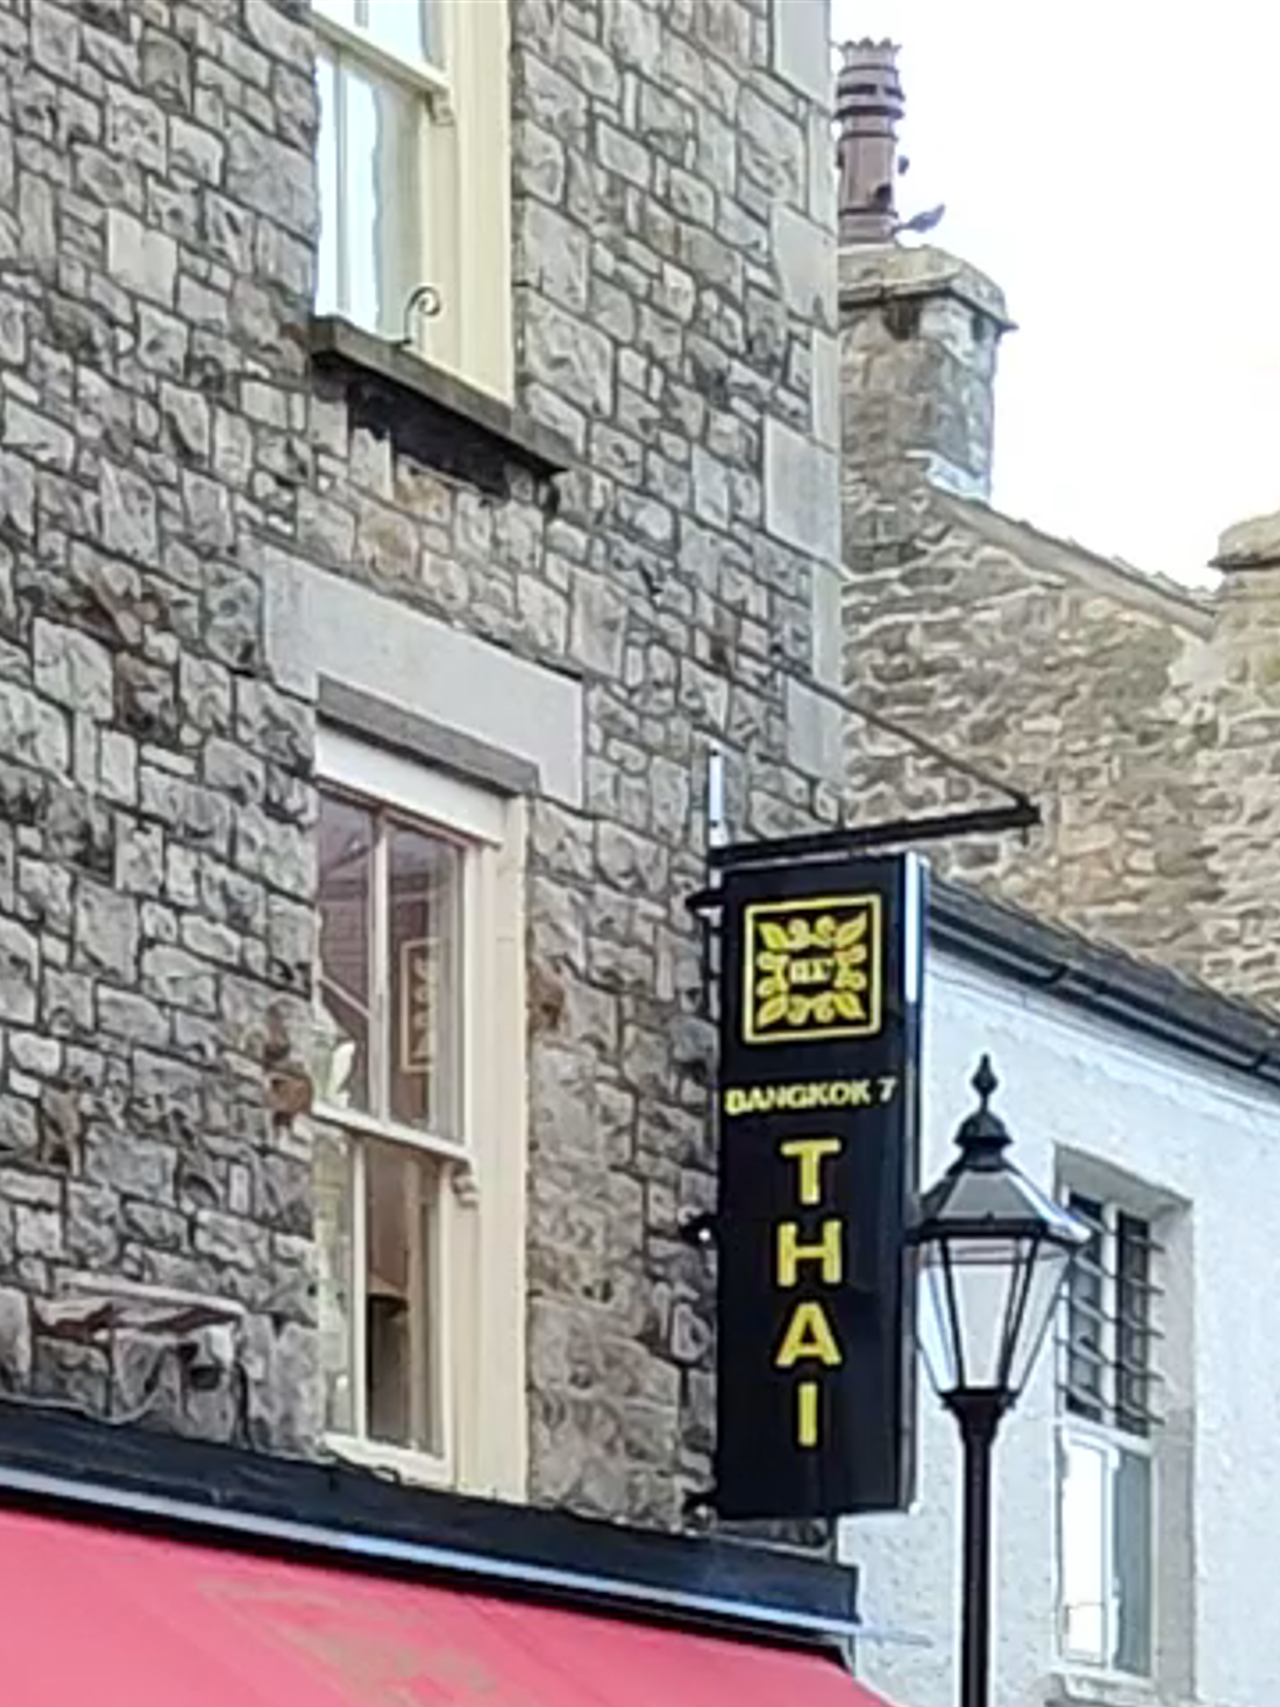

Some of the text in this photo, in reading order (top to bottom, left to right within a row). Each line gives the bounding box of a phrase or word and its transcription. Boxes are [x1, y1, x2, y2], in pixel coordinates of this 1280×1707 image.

[724, 1075, 898, 1115] BANGKOK 7
[775, 1137, 842, 1447] THAI
